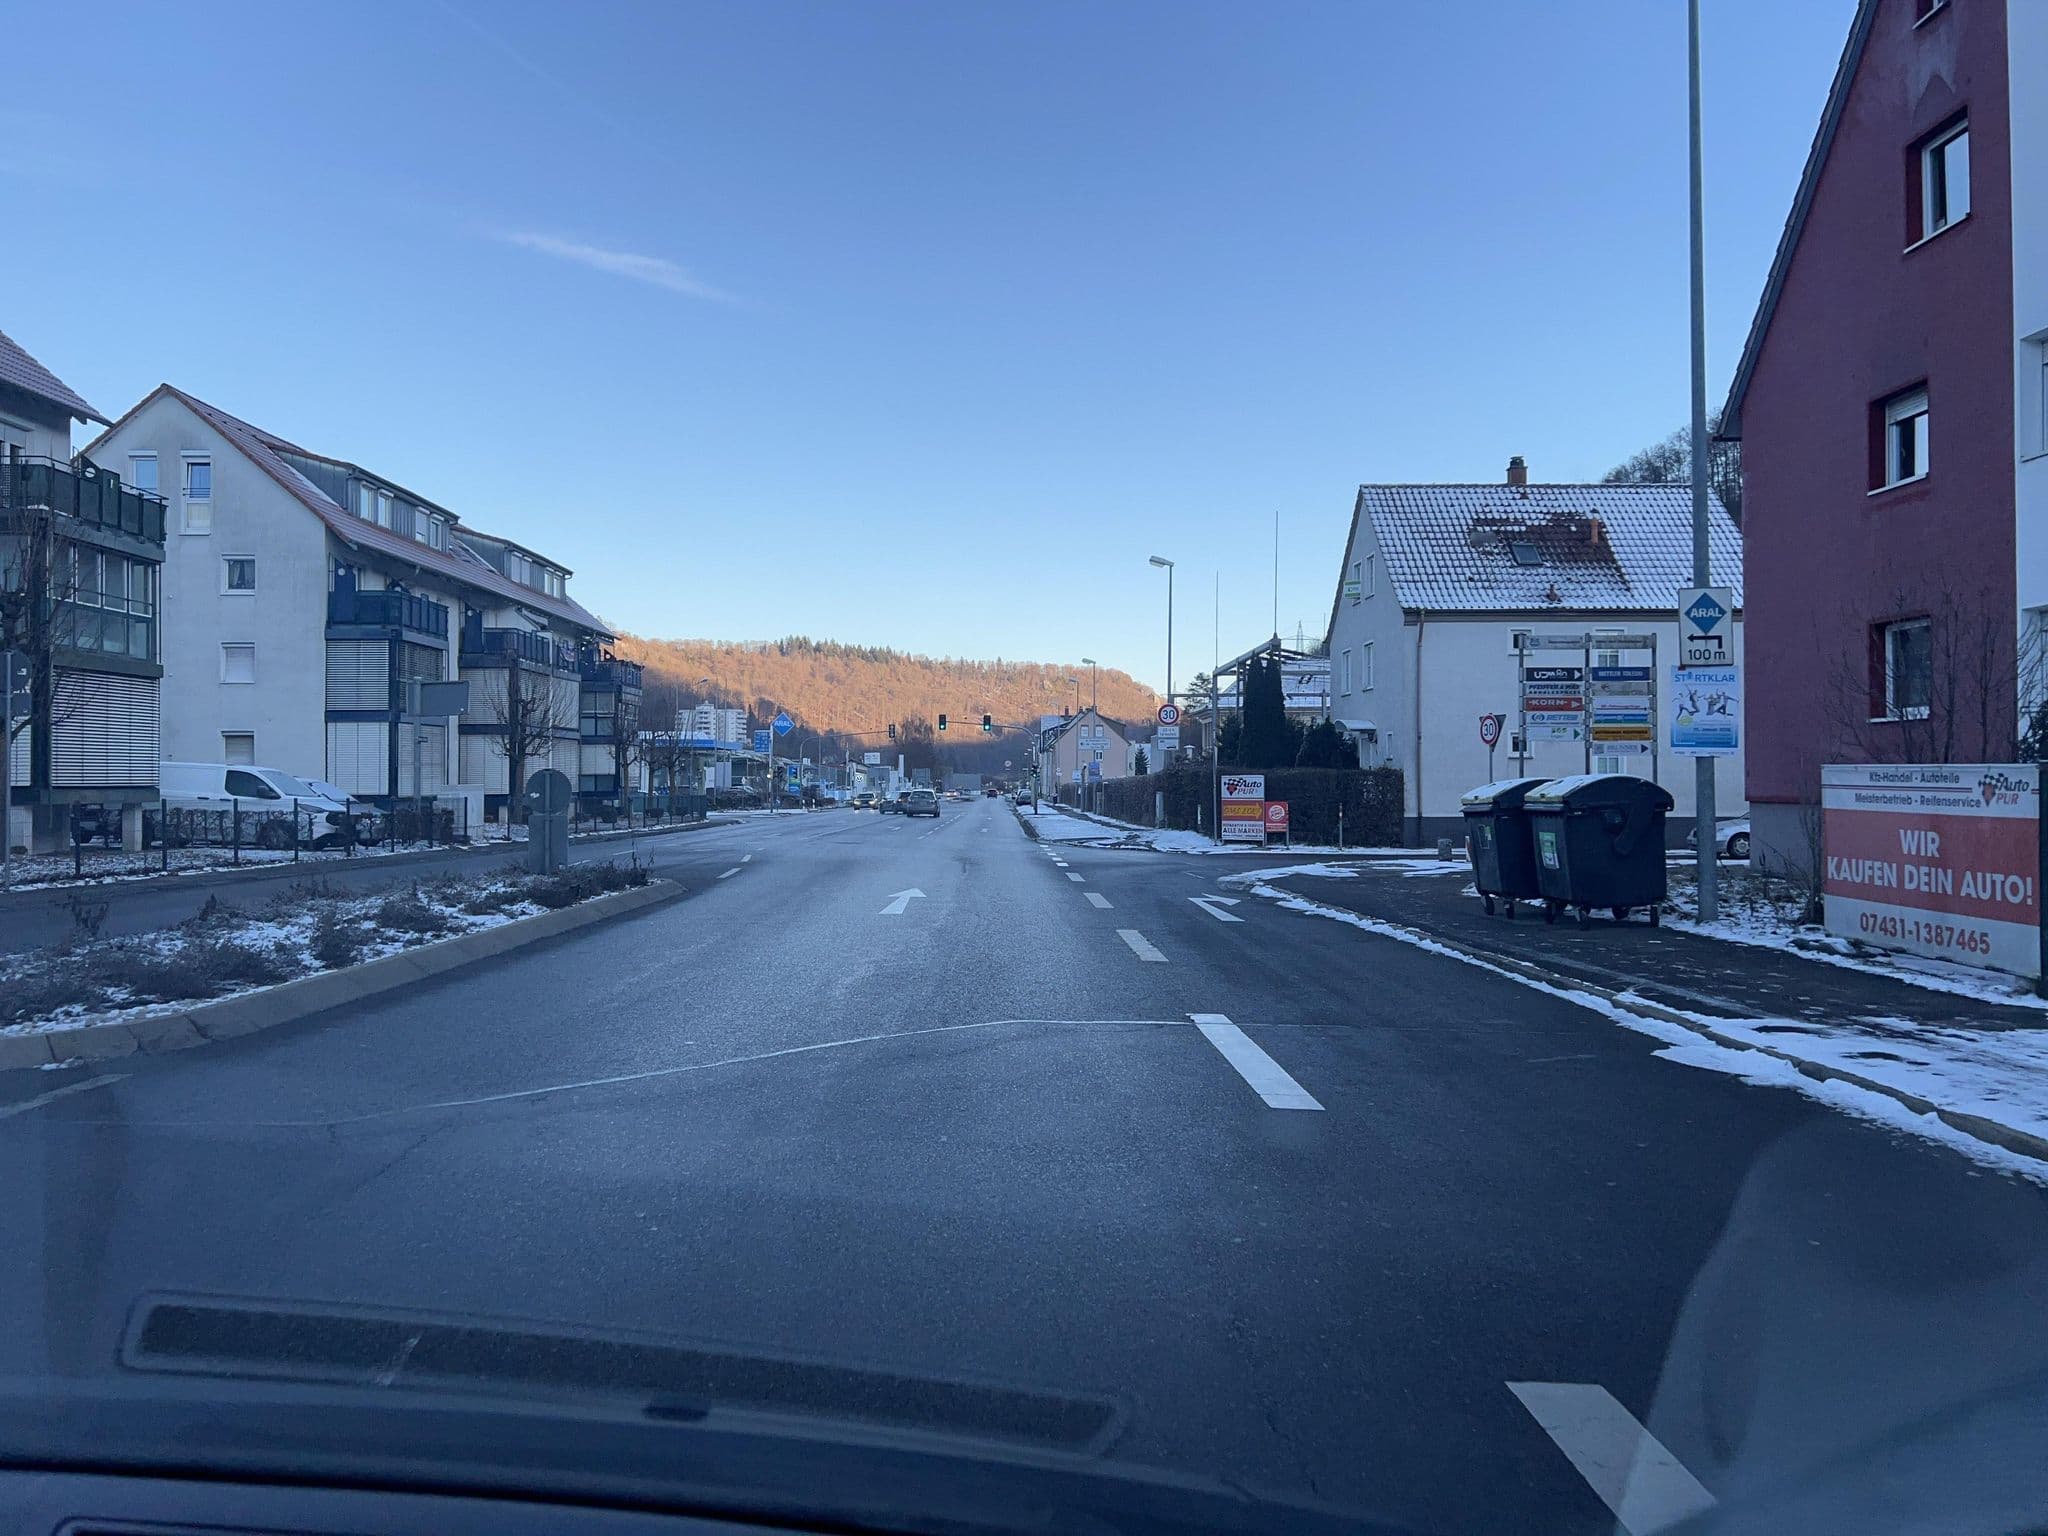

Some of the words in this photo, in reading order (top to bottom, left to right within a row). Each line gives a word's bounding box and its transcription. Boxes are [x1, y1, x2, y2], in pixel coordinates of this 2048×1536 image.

[1690, 607, 1722, 618] ARAL
[1688, 648, 1711, 660] 100
[1714, 651, 1726, 660] m
[1161, 709, 1175, 720] 30
[1484, 722, 1493, 737] 30
[1239, 779, 1262, 788] Auto
[1869, 771, 1913, 783] Kfz-Handel
[1919, 772, 1960, 784] Autoteile
[1998, 776, 2030, 792] Auto
[1855, 792, 1913, 806] Meisterbetrieb
[1919, 794, 1981, 808] Reifenservice
[1996, 793, 2019, 805] PUR
[1899, 829, 1941, 858] WIR
[1826, 855, 1898, 888] KAUFEN
[1904, 864, 1953, 895] DEIN
[1960, 870, 2033, 906] AUTO!
[1859, 911, 1992, 955] 07431-1387465
